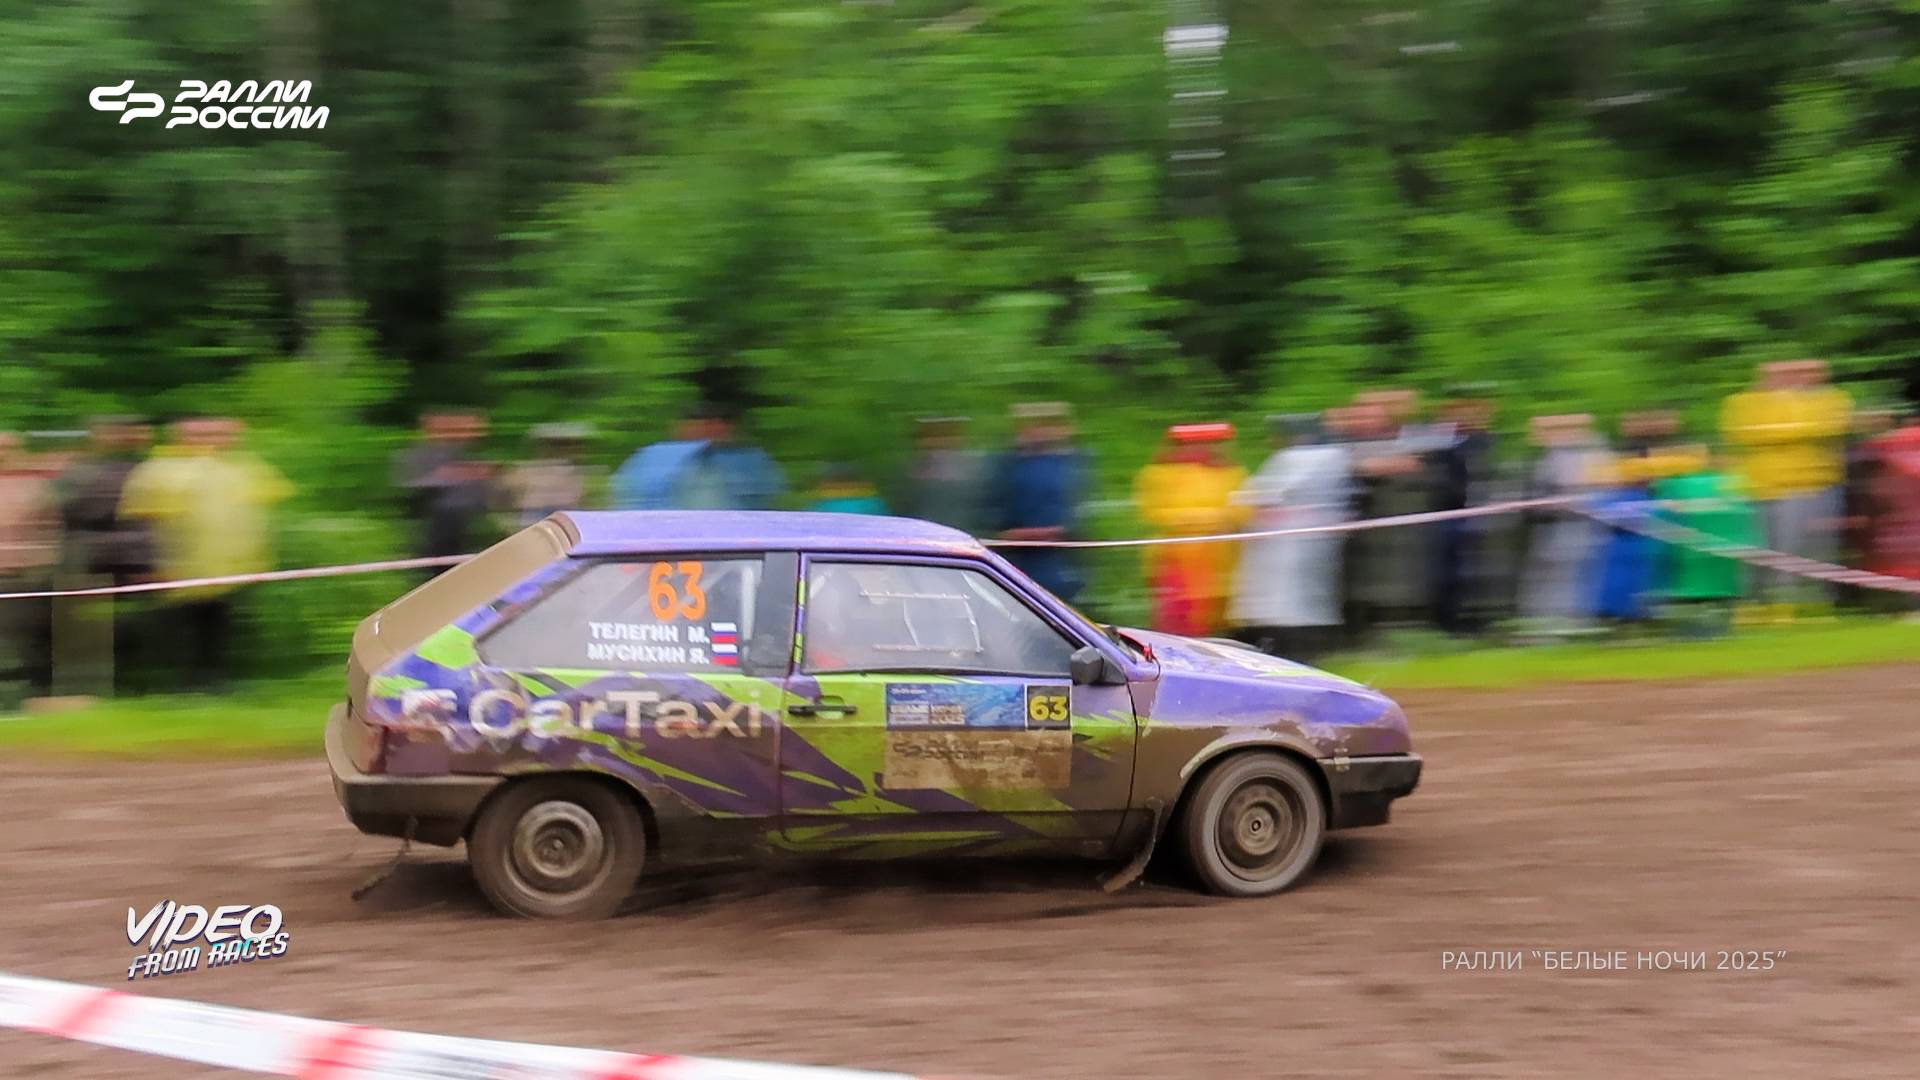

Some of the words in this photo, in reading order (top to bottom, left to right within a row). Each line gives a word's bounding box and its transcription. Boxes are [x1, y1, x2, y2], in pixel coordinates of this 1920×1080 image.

[648, 560, 707, 622] 63
[588, 621, 679, 642] ТЕЛЕГИН
[586, 642, 687, 664] МУСИХИН
[1029, 694, 1069, 722] 63
